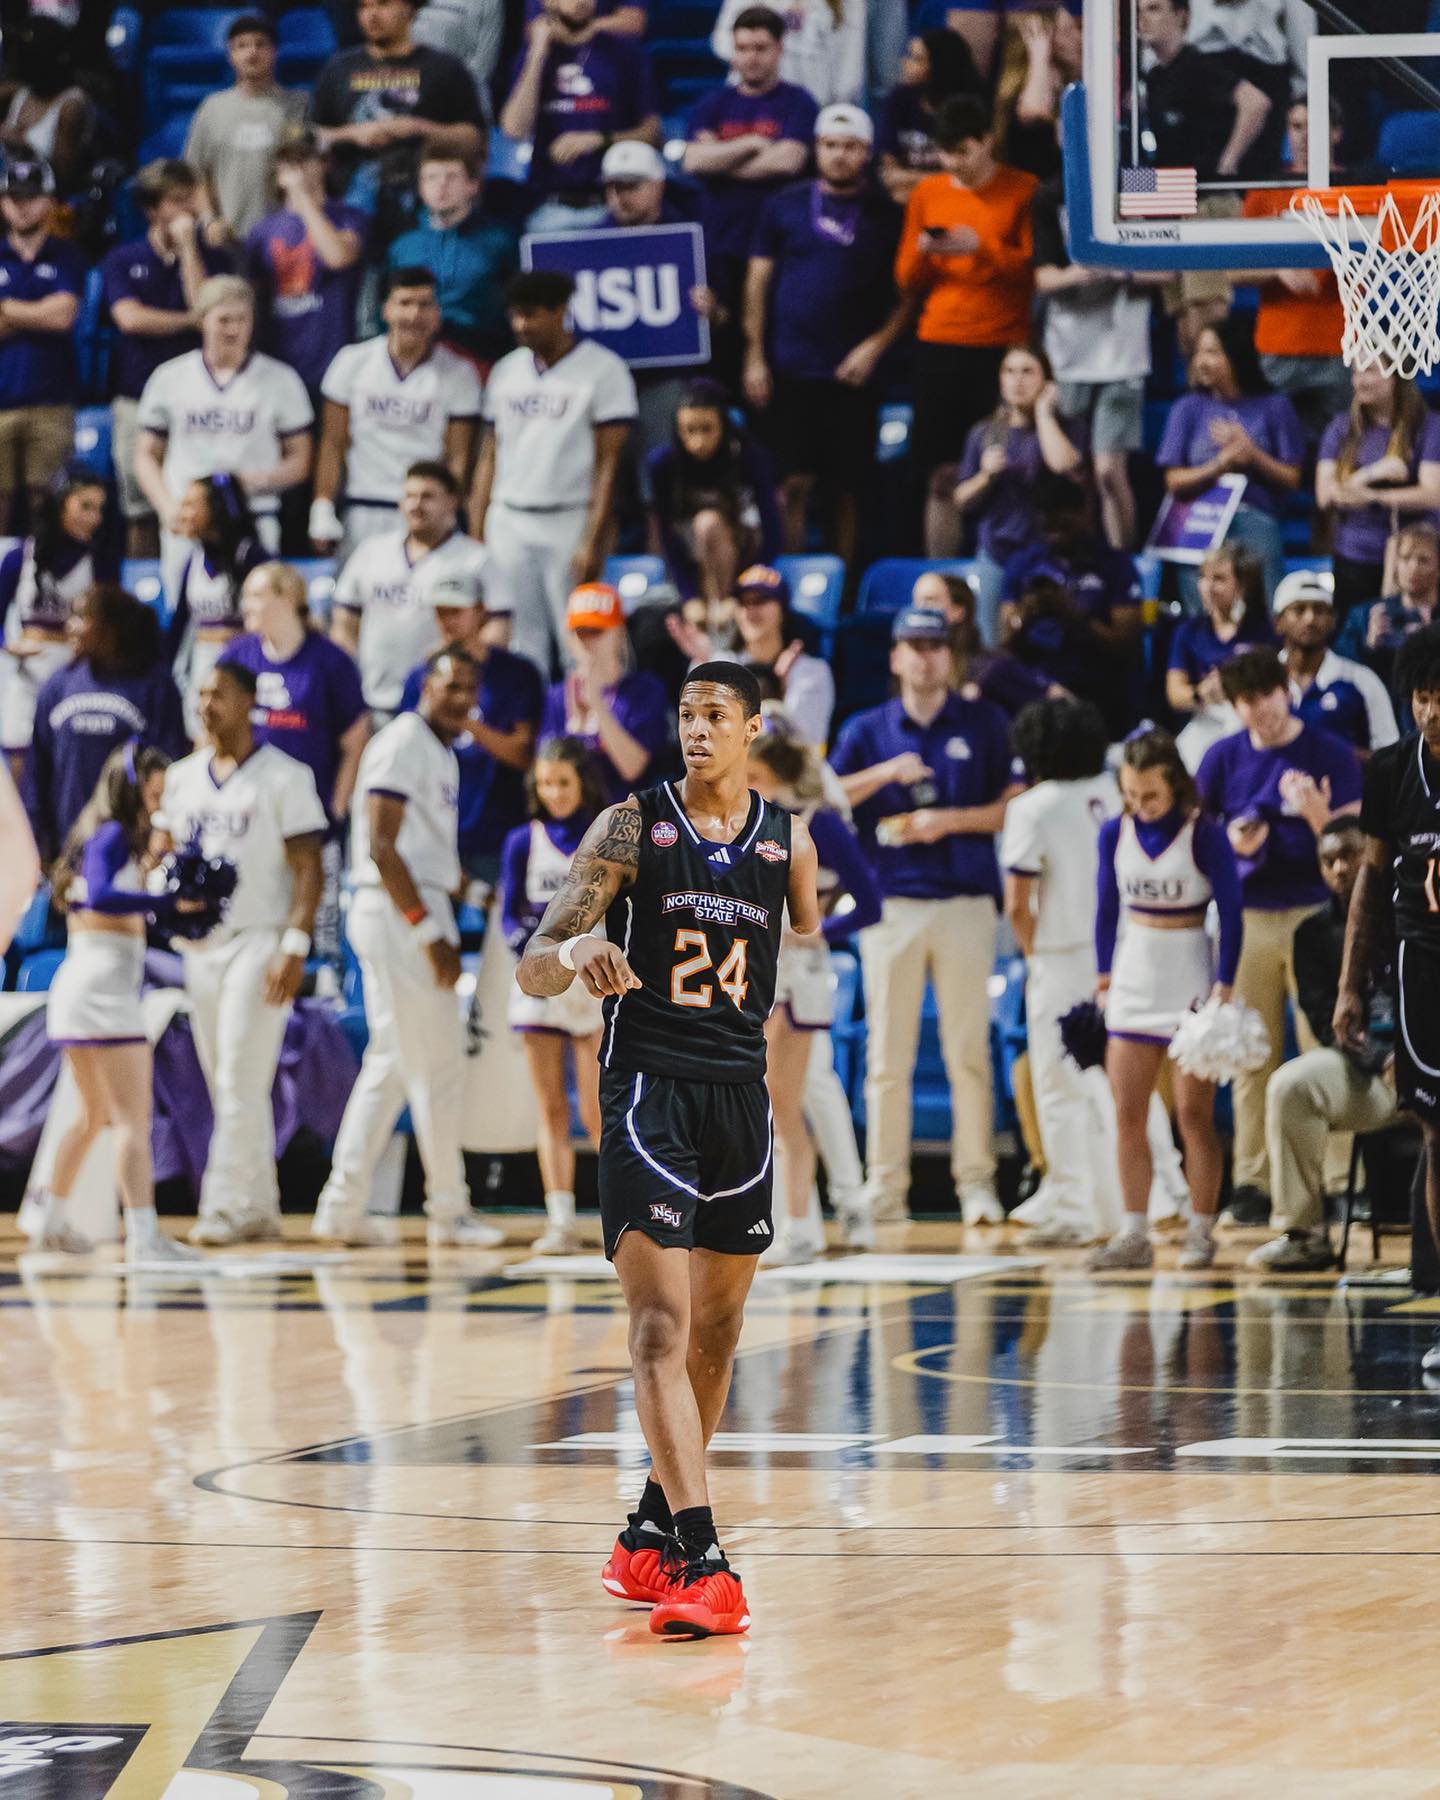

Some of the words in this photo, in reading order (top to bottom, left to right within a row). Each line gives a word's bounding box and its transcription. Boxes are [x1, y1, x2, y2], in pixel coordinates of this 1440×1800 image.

[567, 263, 682, 332] NSU
[1126, 879, 1183, 900] NSU
[665, 893, 767, 925] NORTHWESTERN
[695, 906, 735, 922] STATE
[671, 928, 749, 1014] 24
[653, 1204, 681, 1227] NSU
